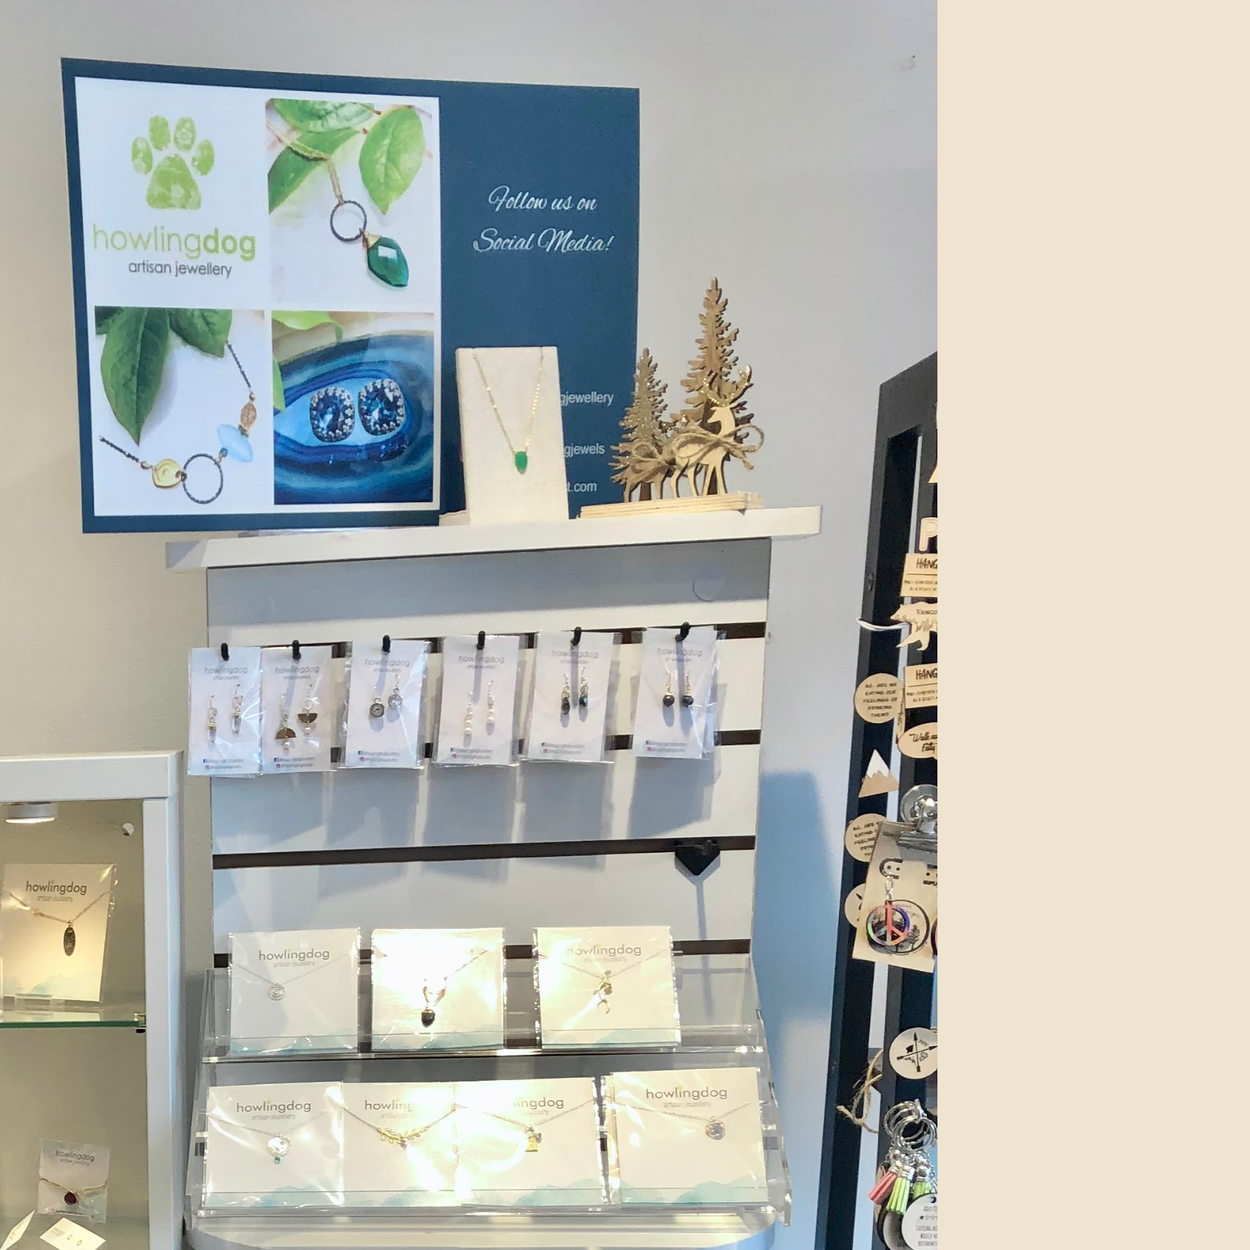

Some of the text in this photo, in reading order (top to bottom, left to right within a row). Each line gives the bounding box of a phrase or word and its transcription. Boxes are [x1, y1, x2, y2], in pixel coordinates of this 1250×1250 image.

[488, 185, 597, 212] Follow us on
[92, 223, 256, 262] howlingdog
[473, 228, 615, 253] Social Media!
[128, 260, 232, 279] artisan jewellery
[25, 881, 87, 896] howlingdog
[258, 947, 330, 962] howlingdog
[646, 1085, 728, 1101] howlingdog
[236, 1100, 311, 1113] howlingdog
[364, 1100, 415, 1113] howling
[513, 1097, 564, 1110] lingdog
[55, 1150, 95, 1162] howlingdog
